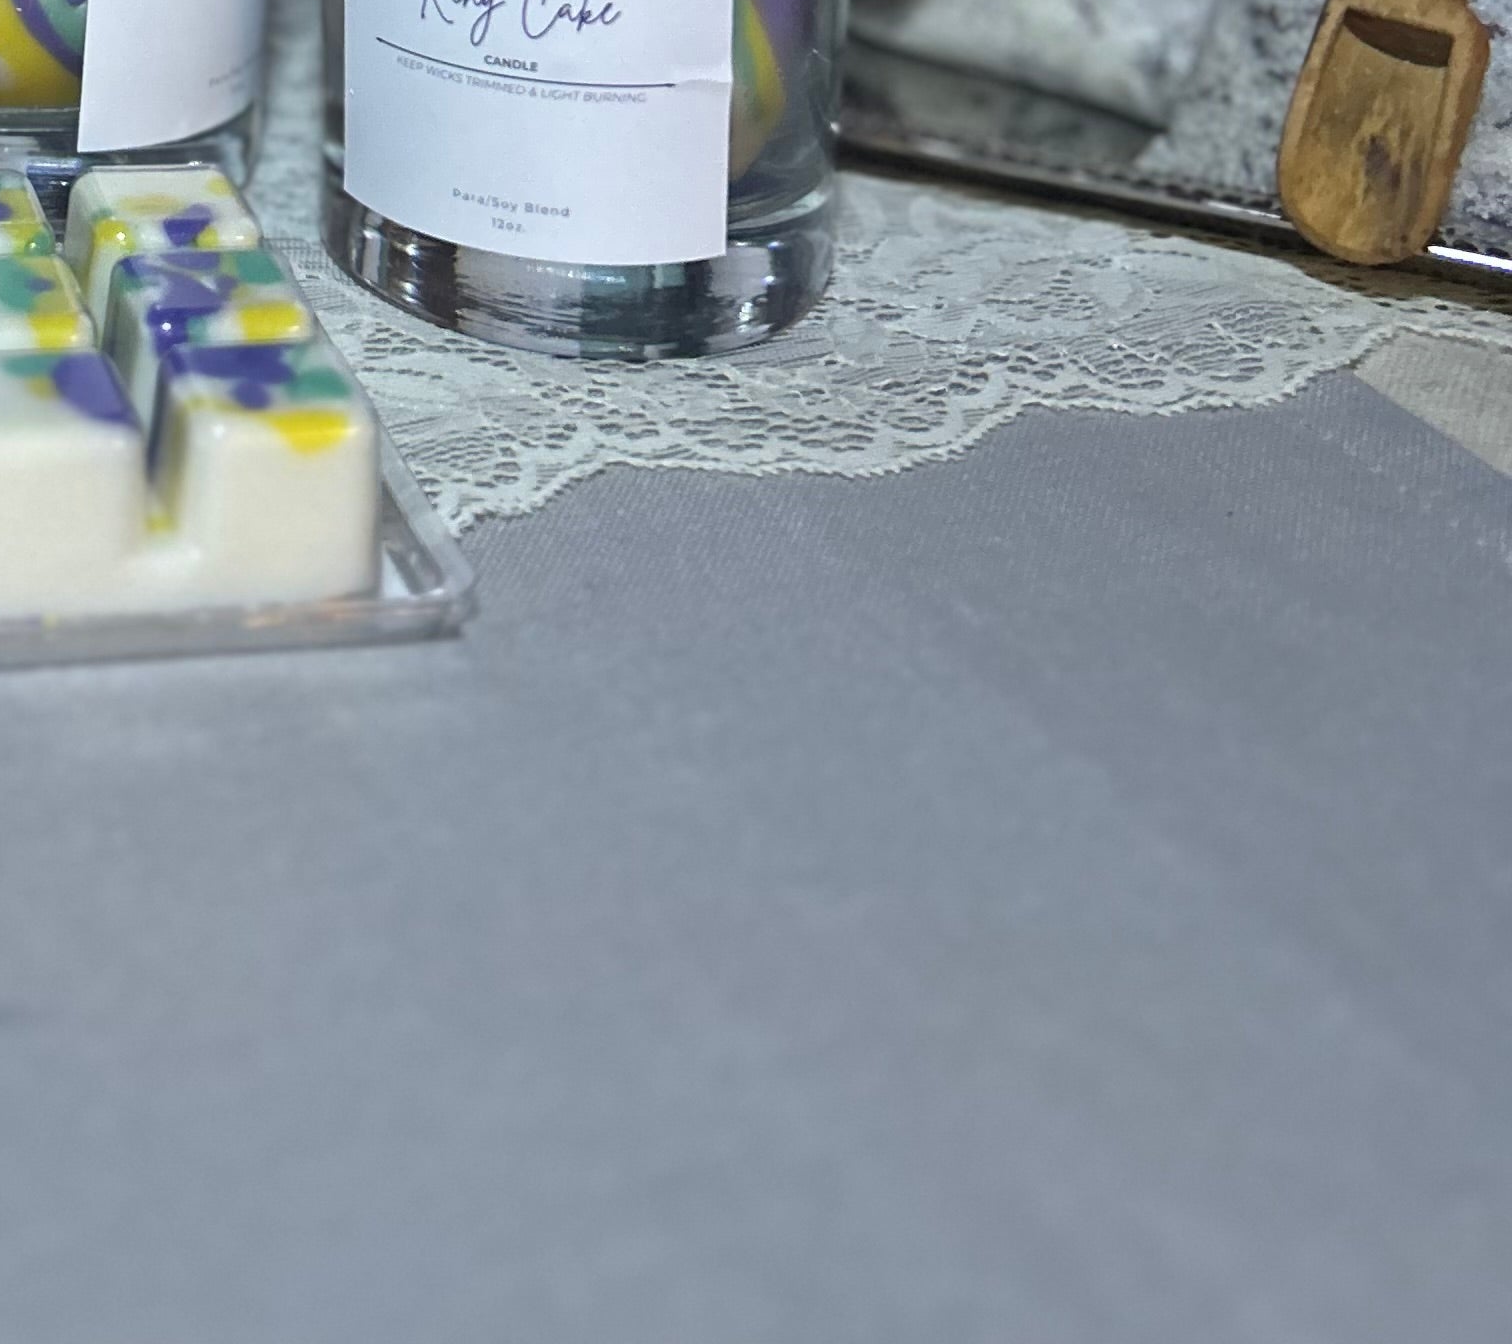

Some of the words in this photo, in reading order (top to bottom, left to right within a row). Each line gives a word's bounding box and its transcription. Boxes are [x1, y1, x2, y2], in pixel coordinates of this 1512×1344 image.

[483, 54, 539, 72] CANDLE
[396, 54, 424, 72] KEEP
[426, 64, 463, 85] WICKS
[465, 73, 526, 96] TRIMMED
[540, 88, 580, 102] LIGHT
[583, 90, 648, 104] BURNING
[452, 187, 519, 213] Para/Soy
[524, 201, 571, 218] Blend
